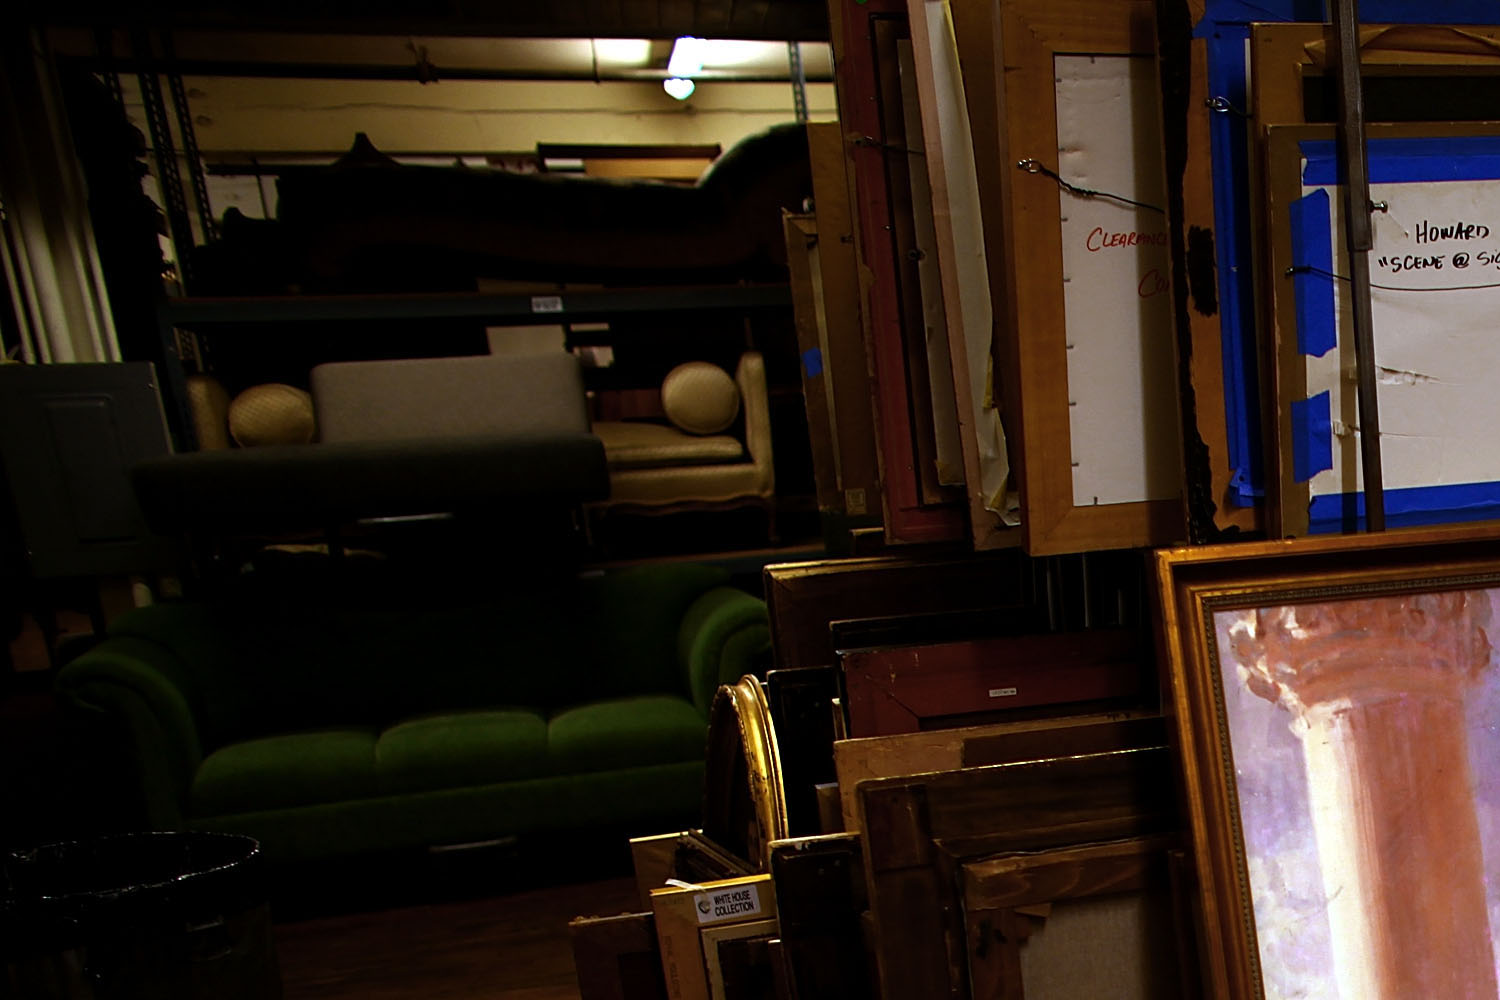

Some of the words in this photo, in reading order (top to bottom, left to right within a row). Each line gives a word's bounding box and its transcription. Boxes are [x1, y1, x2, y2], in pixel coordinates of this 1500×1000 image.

[1415, 220, 1490, 244] HOWARD
[1452, 252, 1470, 269] @
[714, 893, 731, 905] WHITE
[731, 890, 751, 902] HOUSE
[714, 900, 754, 916] COLLECTION
